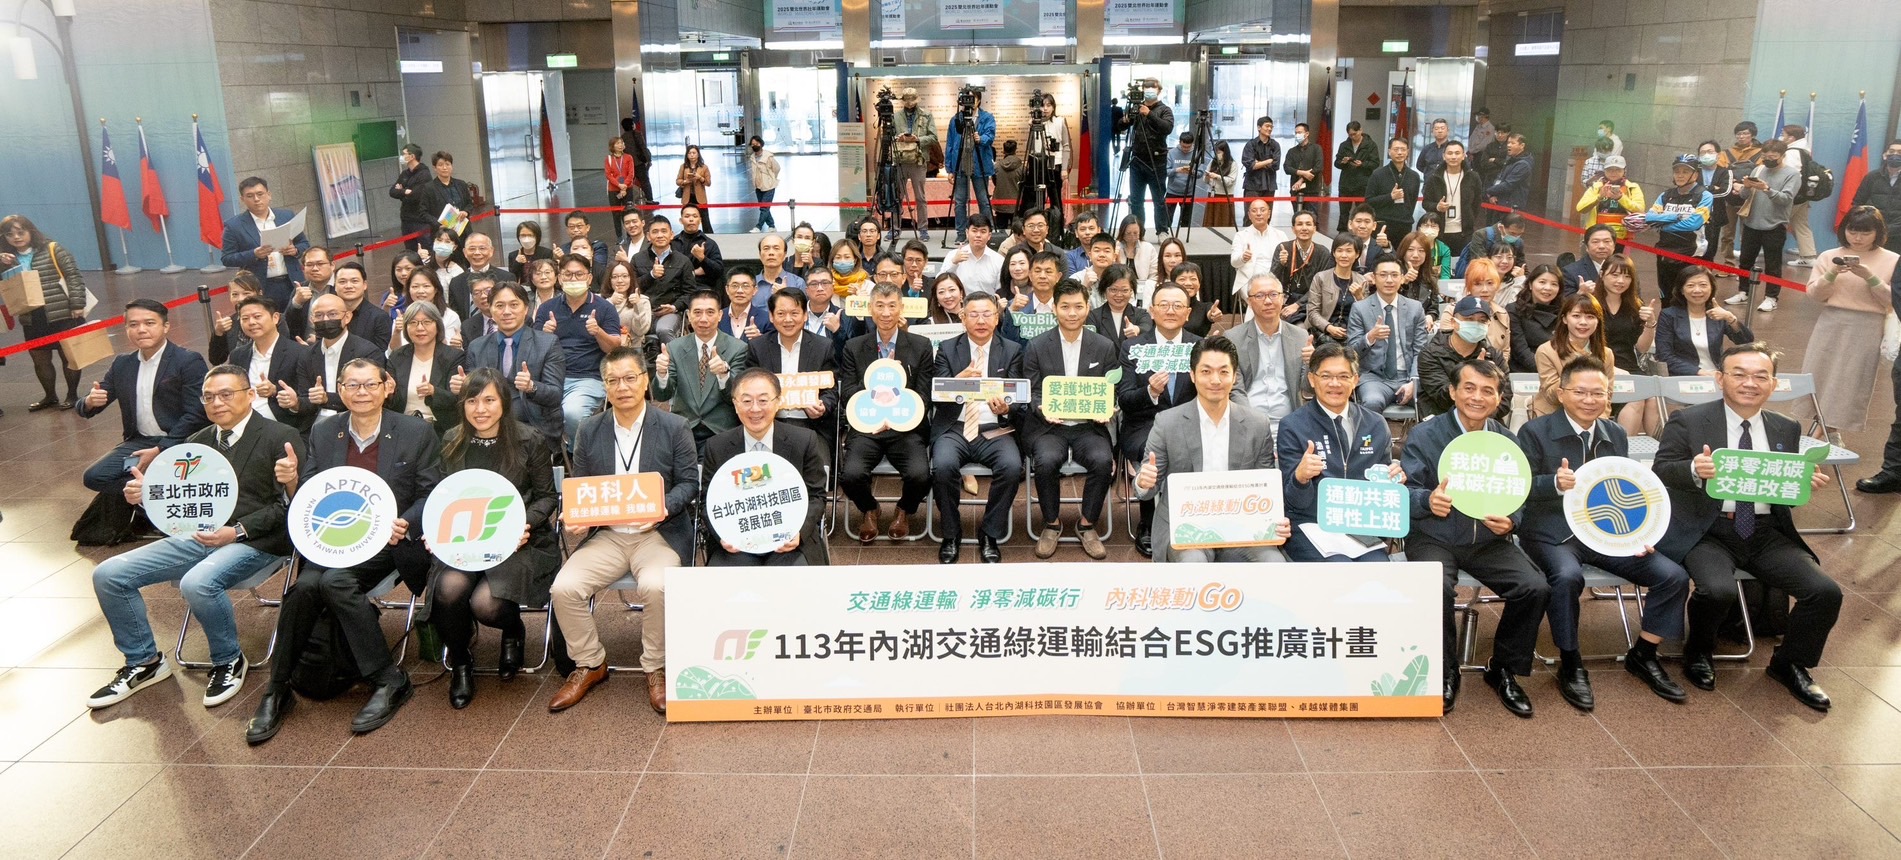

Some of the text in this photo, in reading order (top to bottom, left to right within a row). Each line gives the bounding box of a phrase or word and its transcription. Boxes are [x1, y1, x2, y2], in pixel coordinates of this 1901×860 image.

[1012, 314, 1058, 325] YouBik
[1048, 381, 1108, 397] 愛護地球
[1048, 398, 1107, 414] 永續發展
[1450, 452, 1490, 473] 我的
[1718, 455, 1805, 479] 淨零減碳
[731, 463, 772, 486] TPDA
[148, 482, 230, 501] 臺北市政府
[324, 479, 382, 506] APTRC
[576, 479, 649, 505] 內科人
[1326, 485, 1401, 509] 通勤共乘
[1715, 476, 1801, 499] 交通改善
[166, 502, 214, 519] 交通局
[712, 486, 802, 520] 台北內湖科技園區
[303, 498, 381, 555] NATIONAL TAIWAN UNIVERSITY
[738, 510, 783, 533] 發展協會
[1325, 507, 1401, 531] 彈性上班
[847, 590, 958, 611] 交通綠運輸
[969, 587, 1081, 609] 淨零減碳行
[774, 626, 1378, 662] 113年內湖交通綠運輸結合ESG推廣計畫
[753, 705, 793, 715] 主辦單位
[803, 704, 883, 714] 臺北市政府交通局
[895, 703, 935, 713] 執行單位
[945, 700, 1103, 712] 社團法人台北內湖科技園區發展協會
[1116, 701, 1155, 711] 協辦單位
